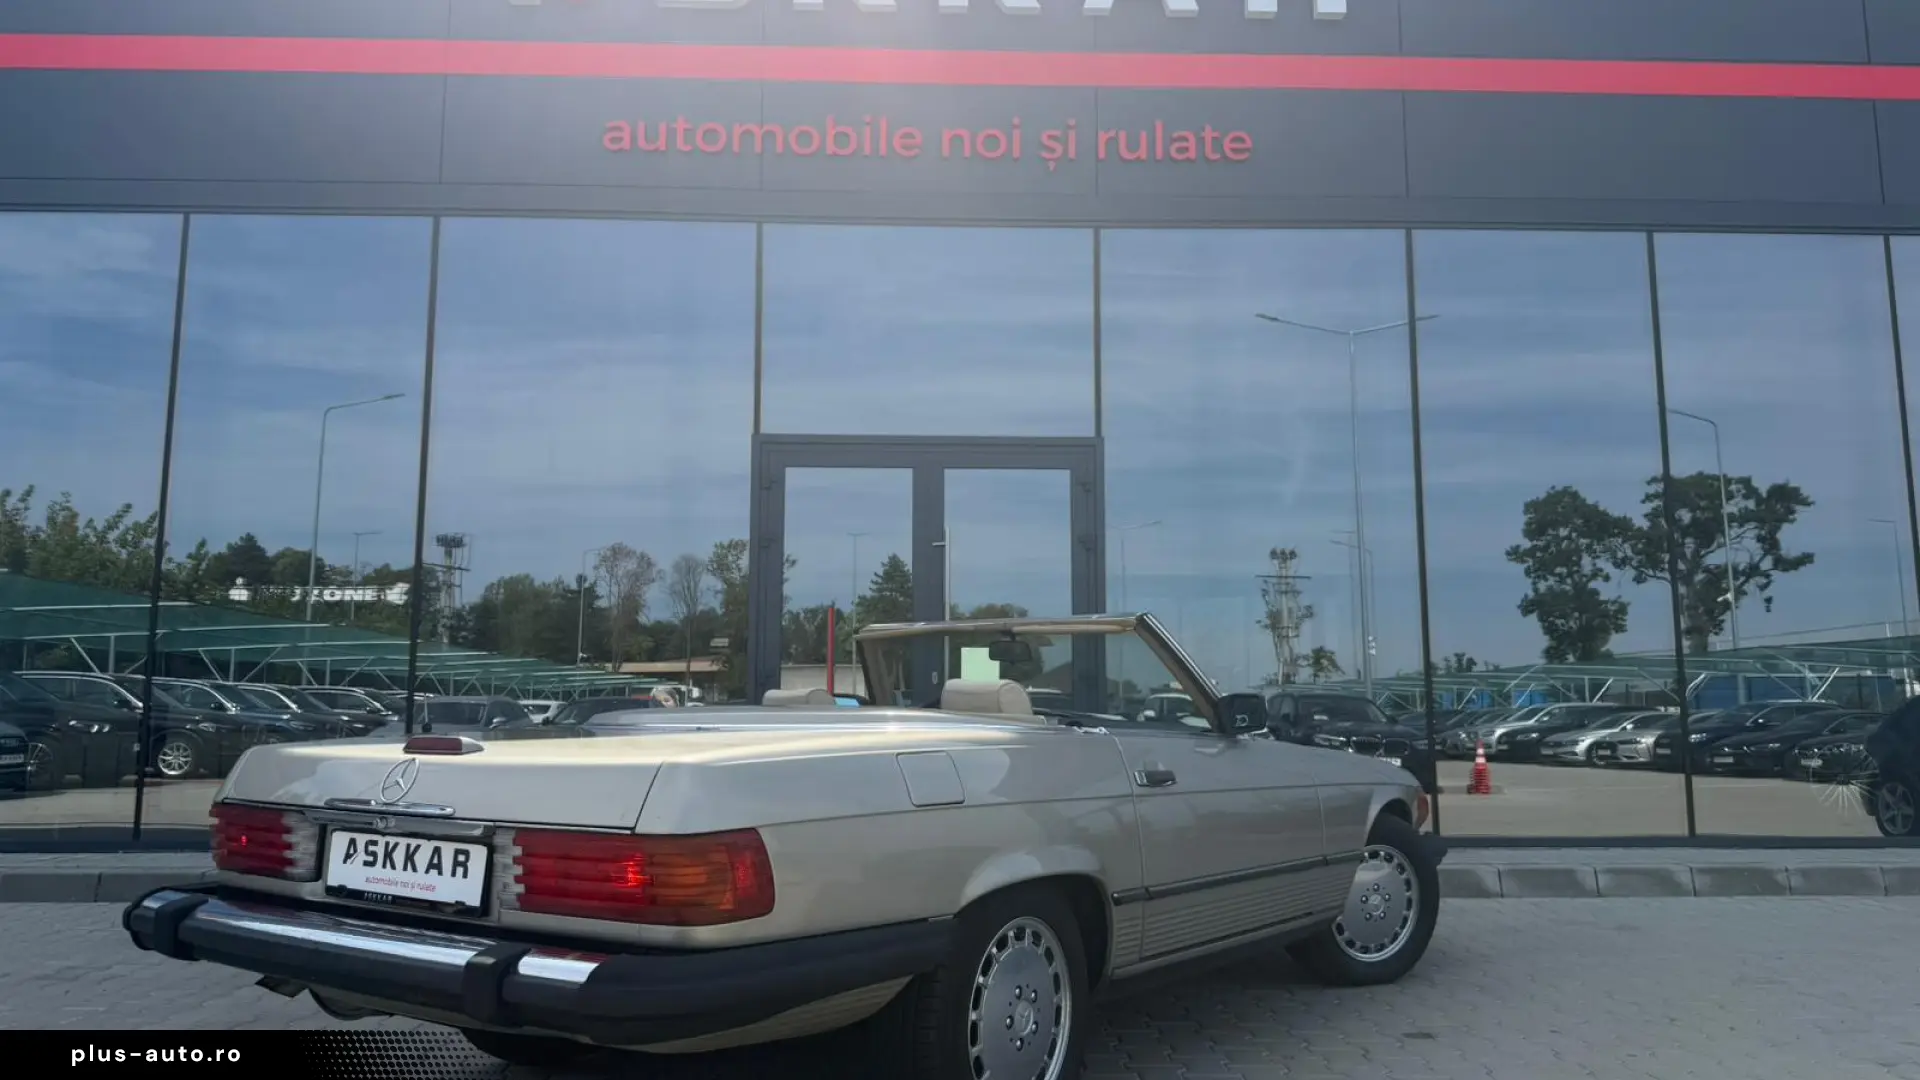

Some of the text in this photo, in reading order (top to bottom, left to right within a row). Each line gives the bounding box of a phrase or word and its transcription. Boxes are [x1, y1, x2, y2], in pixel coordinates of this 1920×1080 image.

[602, 115, 1253, 171] automobile noi și rulate
[342, 837, 471, 879] ASKKAR
